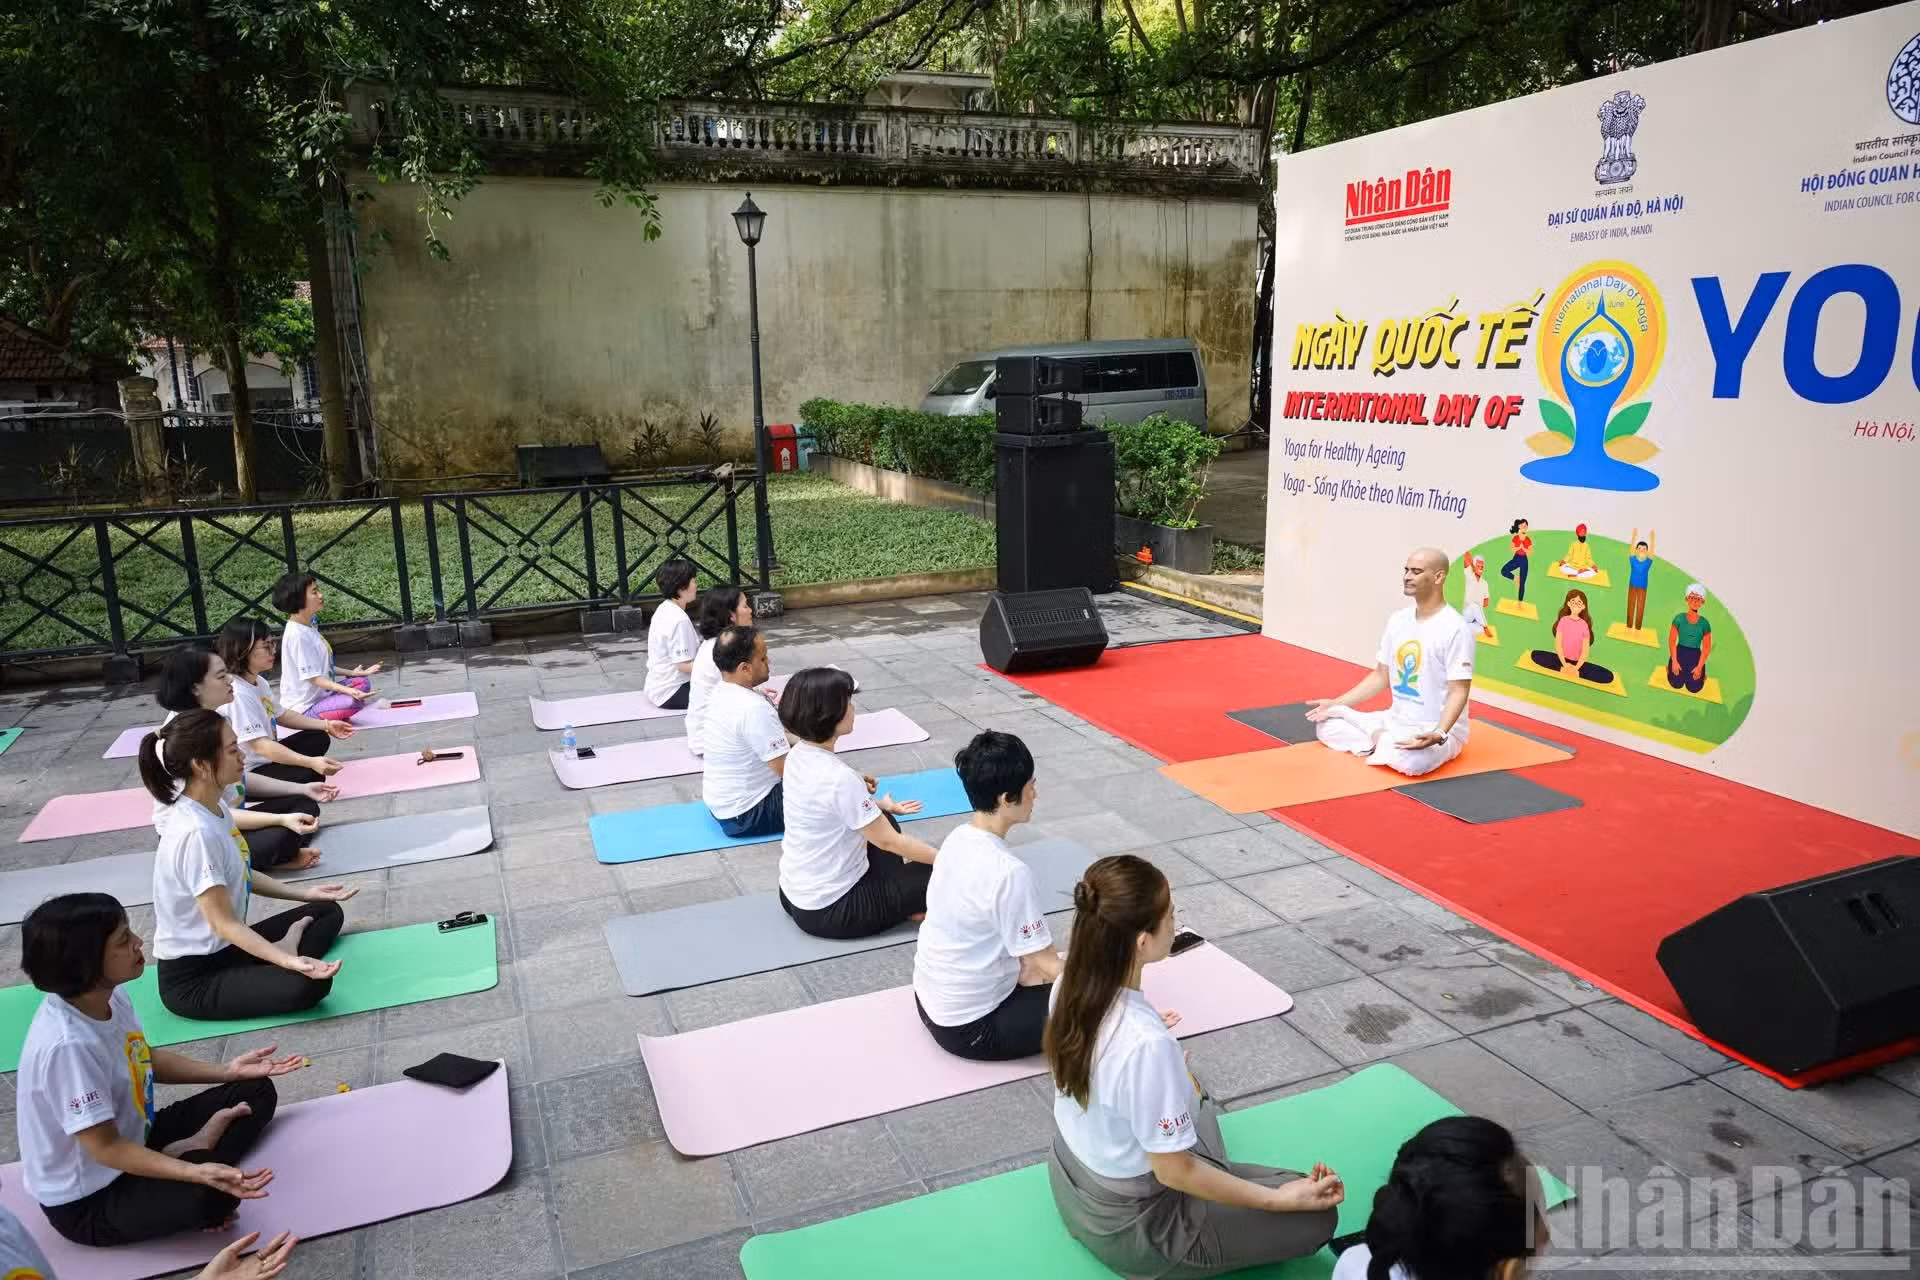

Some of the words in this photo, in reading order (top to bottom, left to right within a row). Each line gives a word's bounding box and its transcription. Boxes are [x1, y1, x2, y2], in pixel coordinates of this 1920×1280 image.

[1853, 154, 1877, 164] Indian
[1879, 149, 1909, 160] Council
[1345, 176, 1401, 218] Nhân
[1405, 167, 1451, 208] Dân
[1801, 174, 1824, 196] HỘI
[1869, 164, 1909, 185] QUAN
[1548, 212, 1563, 229] ĐẠI
[1580, 205, 1608, 223] QUÁN
[1646, 196, 1660, 214] HÀ
[1664, 194, 1684, 214] NỘI
[1824, 198, 1855, 212] INDIAN
[1856, 194, 1894, 209] COUNCIL
[1896, 191, 1914, 205] FOR
[1571, 230, 1599, 242] EMBASSY
[1600, 228, 1608, 240] OF
[1552, 276, 1602, 334] International
[1605, 275, 1628, 293] Day
[1627, 288, 1640, 300] of
[1636, 297, 1648, 333] Yoga
[1289, 308, 1368, 370] NGÀY
[1370, 294, 1470, 378] QUỐC
[1473, 288, 1545, 369] TẾ
[1690, 263, 1920, 404] YO
[1283, 391, 1428, 425] INTERNATIONAL
[1433, 394, 1481, 428] DAY
[1484, 395, 1524, 429] OF
[1854, 421, 1878, 437] Hà
[1882, 422, 1915, 442] Nội,
[1284, 437, 1306, 461] Yoga
[1308, 439, 1322, 459] for
[1324, 440, 1365, 468] Healthy
[1365, 444, 1406, 471] Ageing
[1283, 472, 1305, 496] Yoga
[1313, 474, 1338, 501] Sống
[1340, 479, 1366, 501] Khỏe
[1368, 482, 1394, 504] theo
[1396, 485, 1424, 508] Năm
[1428, 488, 1467, 519] Tháng
